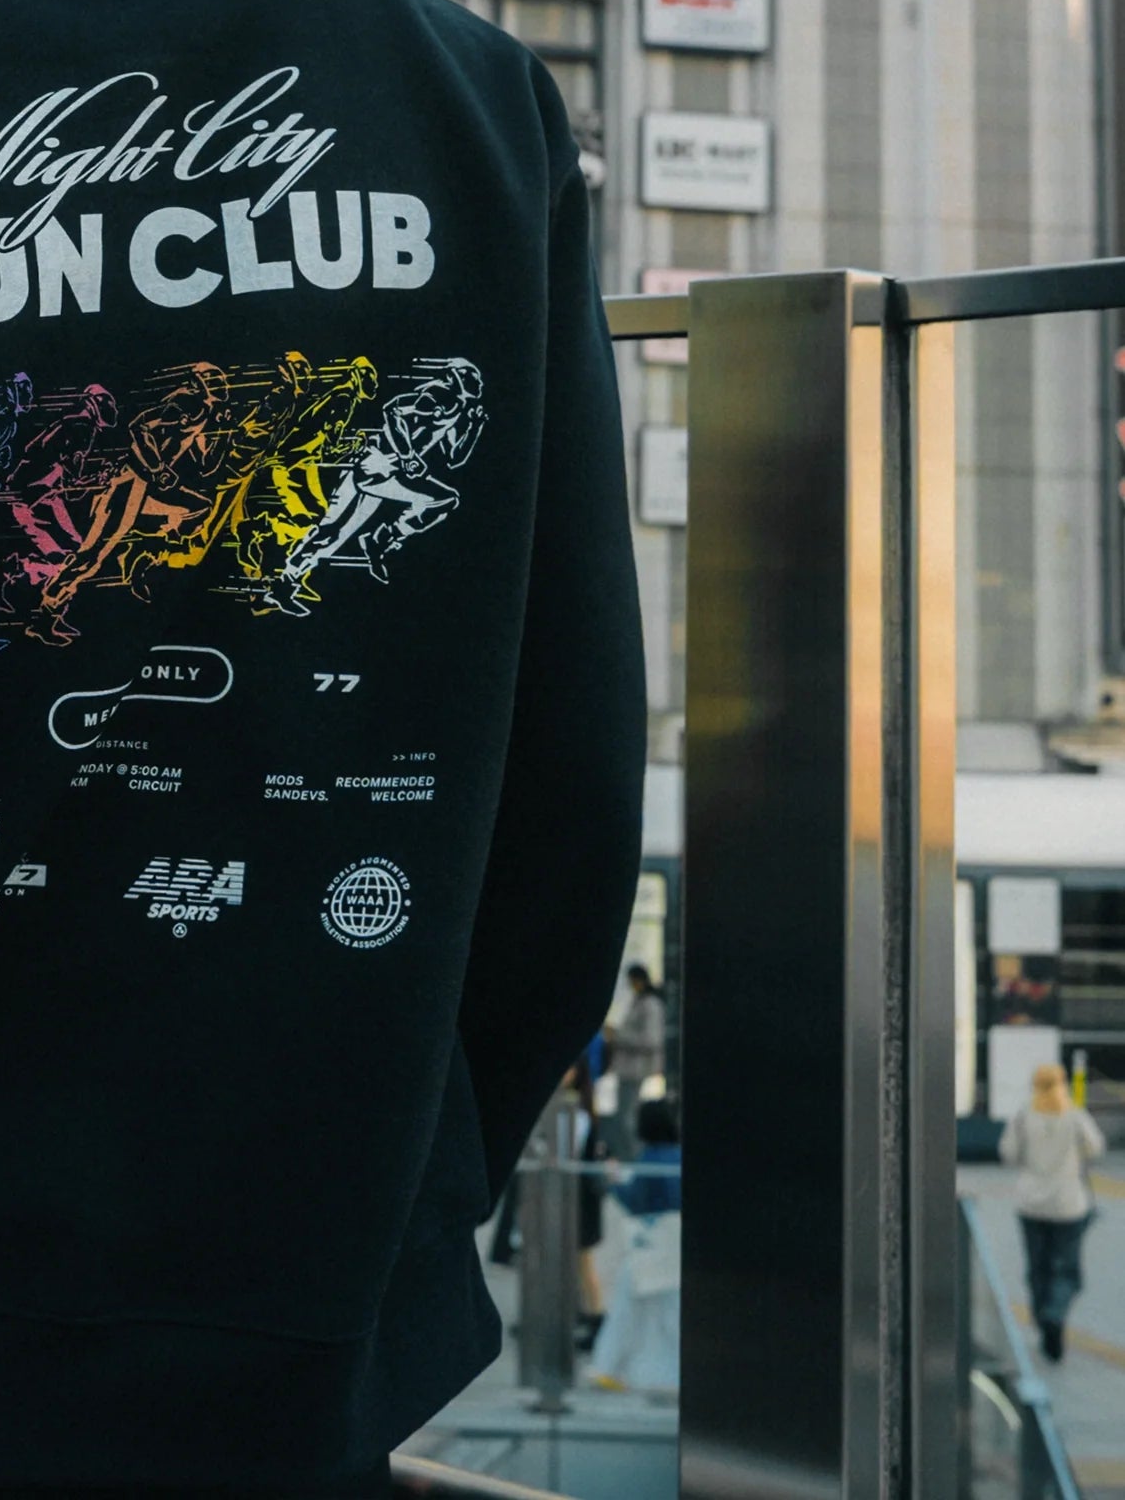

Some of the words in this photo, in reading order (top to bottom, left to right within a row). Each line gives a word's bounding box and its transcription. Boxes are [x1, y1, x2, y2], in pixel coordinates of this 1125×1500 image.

[174, 66, 337, 218] City
[129, 190, 435, 308] CLUB
[141, 665, 200, 681] ONLY
[313, 673, 361, 693] 77
[95, 740, 148, 750] DISTANCE
[409, 752, 436, 761] INFO
[130, 765, 159, 777] 5:00
[161, 767, 182, 779] AM
[128, 779, 182, 792] CIRCUIT
[265, 774, 304, 786] MODS
[335, 776, 435, 788] RECOMMENDED
[264, 788, 329, 801] SANDEVS.
[371, 790, 435, 801] WELCOME
[327, 863, 356, 892] WORLD
[360, 857, 411, 890] AUGMENTED
[346, 895, 384, 906] WAAA
[147, 903, 220, 922] SPORTS
[320, 913, 351, 946] ATHLETICS
[352, 915, 409, 949] ASSOCIATIONS
